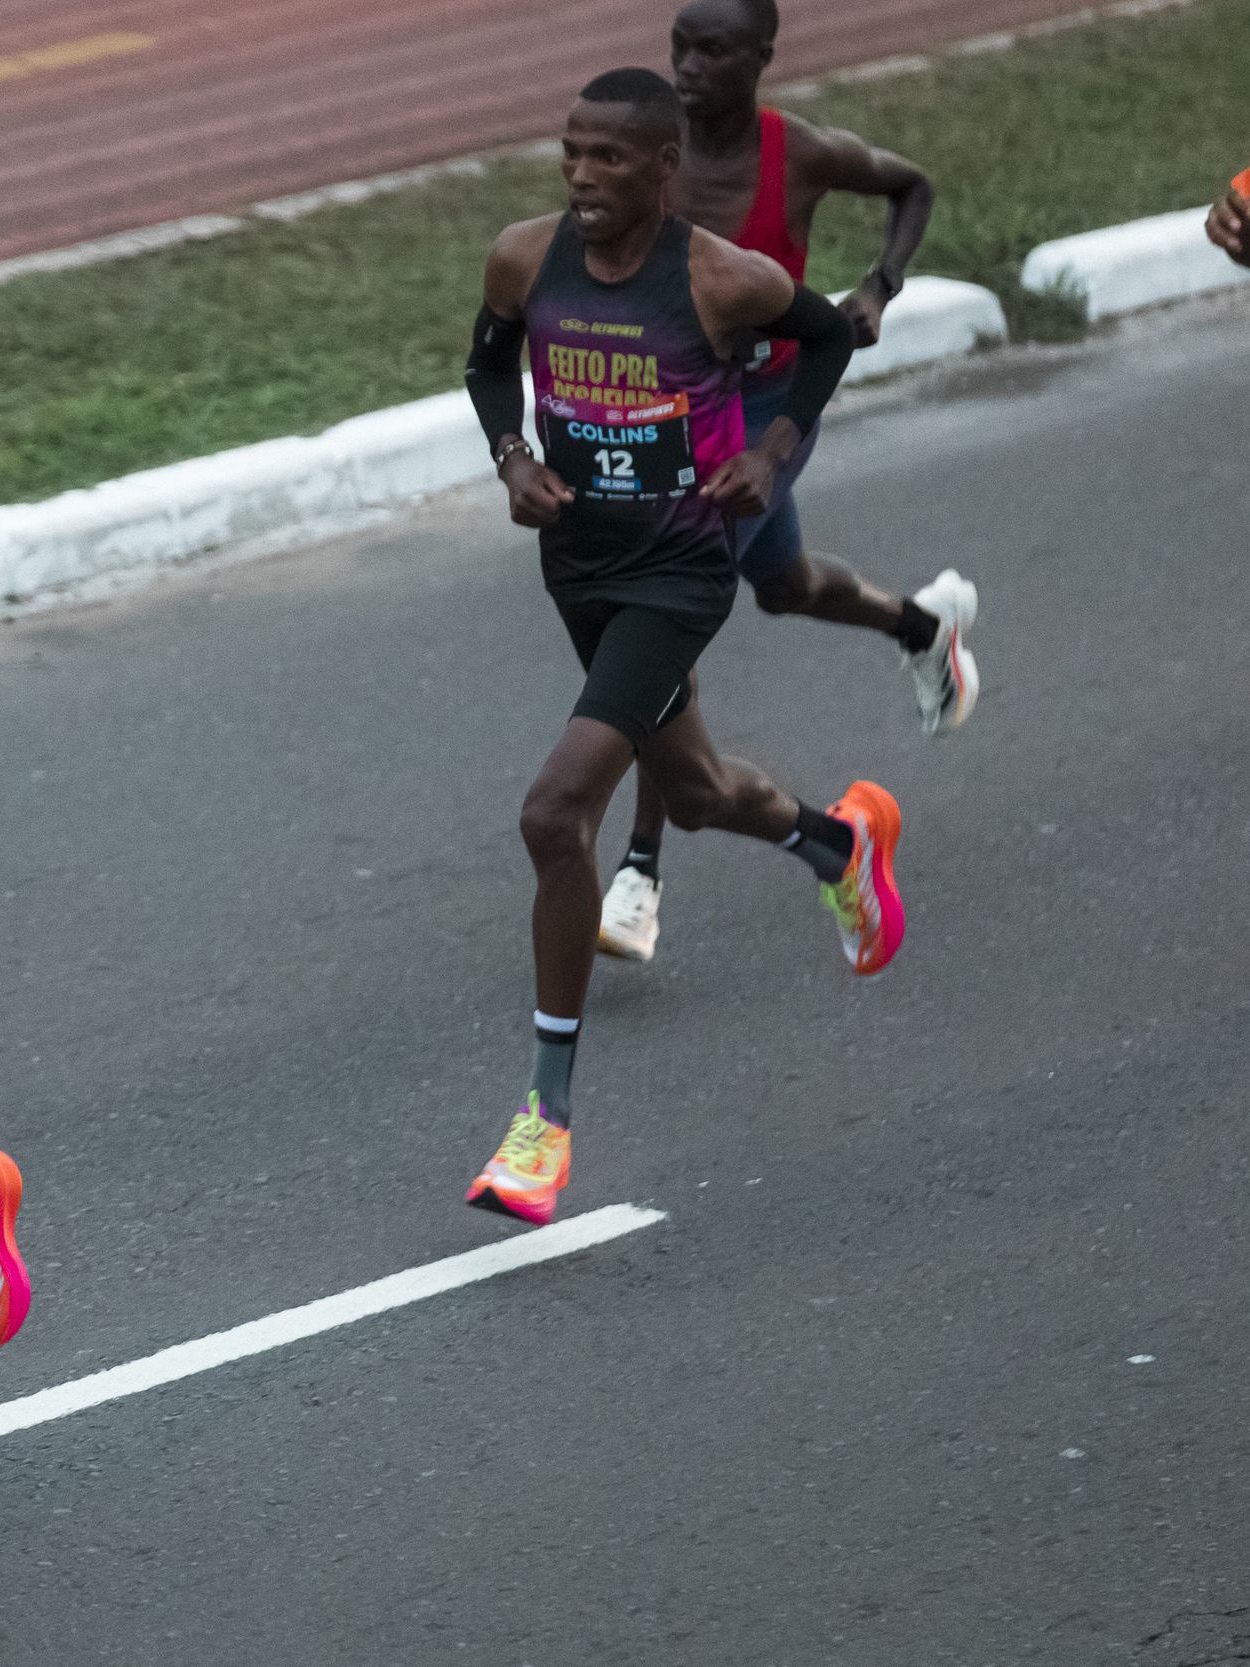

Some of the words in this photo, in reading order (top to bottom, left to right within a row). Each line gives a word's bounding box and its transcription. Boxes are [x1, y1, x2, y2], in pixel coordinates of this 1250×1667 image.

[548, 343, 606, 384] FEITO
[611, 352, 659, 390] PRA
[568, 421, 659, 444] COLLINS
[594, 448, 635, 477] 12
